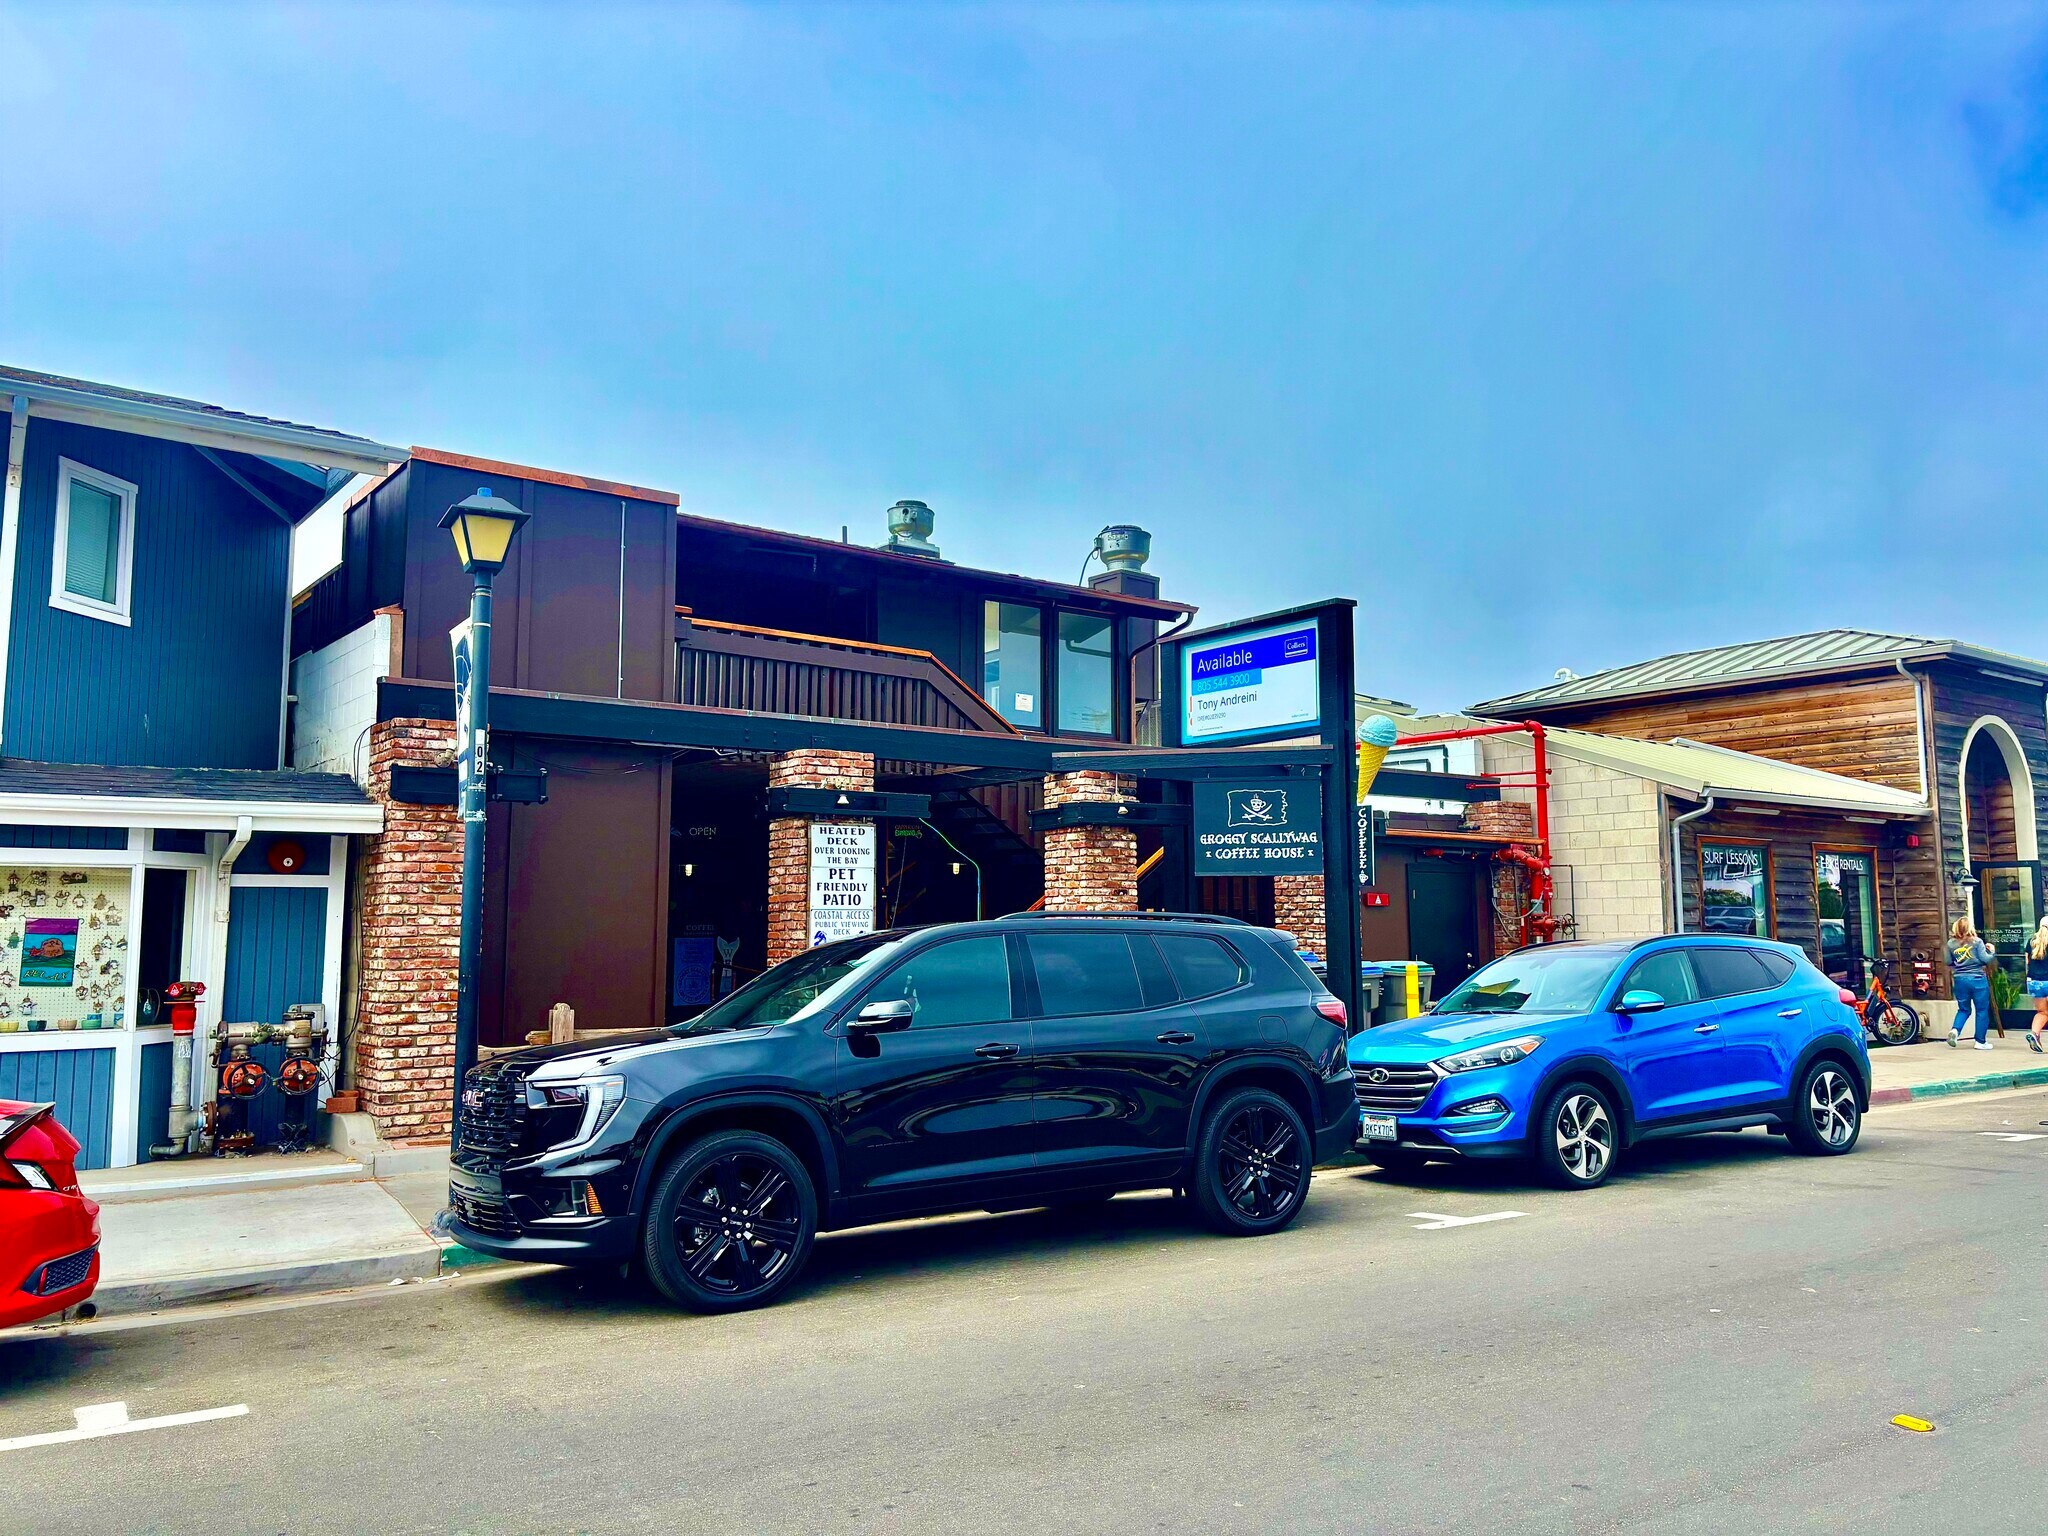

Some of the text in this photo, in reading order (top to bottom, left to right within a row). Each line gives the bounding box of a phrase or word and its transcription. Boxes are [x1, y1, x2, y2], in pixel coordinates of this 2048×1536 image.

[1287, 642, 1306, 650] Colliers
[1197, 649, 1253, 673] Available
[1197, 673, 1250, 692] 805 544 3900
[1198, 691, 1257, 711] Tony Andreini
[689, 827, 717, 836] OPEN
[819, 826, 866, 836] HEATED
[827, 837, 858, 846] DECK
[1200, 831, 1318, 845] GROGGY SCALLYWAG
[1357, 807, 1368, 869] COFFEE
[814, 846, 871, 855] OVER LOOKING
[1215, 846, 1304, 859] COFFEE HOUSE
[827, 856, 842, 864] THE
[1704, 851, 1759, 866] SURF LESSONS
[1840, 859, 1864, 871] RENTALS
[829, 868, 856, 880] PET
[816, 882, 868, 892] FRIENDLY
[823, 894, 862, 906] PATIO
[814, 910, 870, 920] COASTAL ACCESS
[840, 920, 869, 928] VIEWING
[833, 928, 851, 936] DECK
